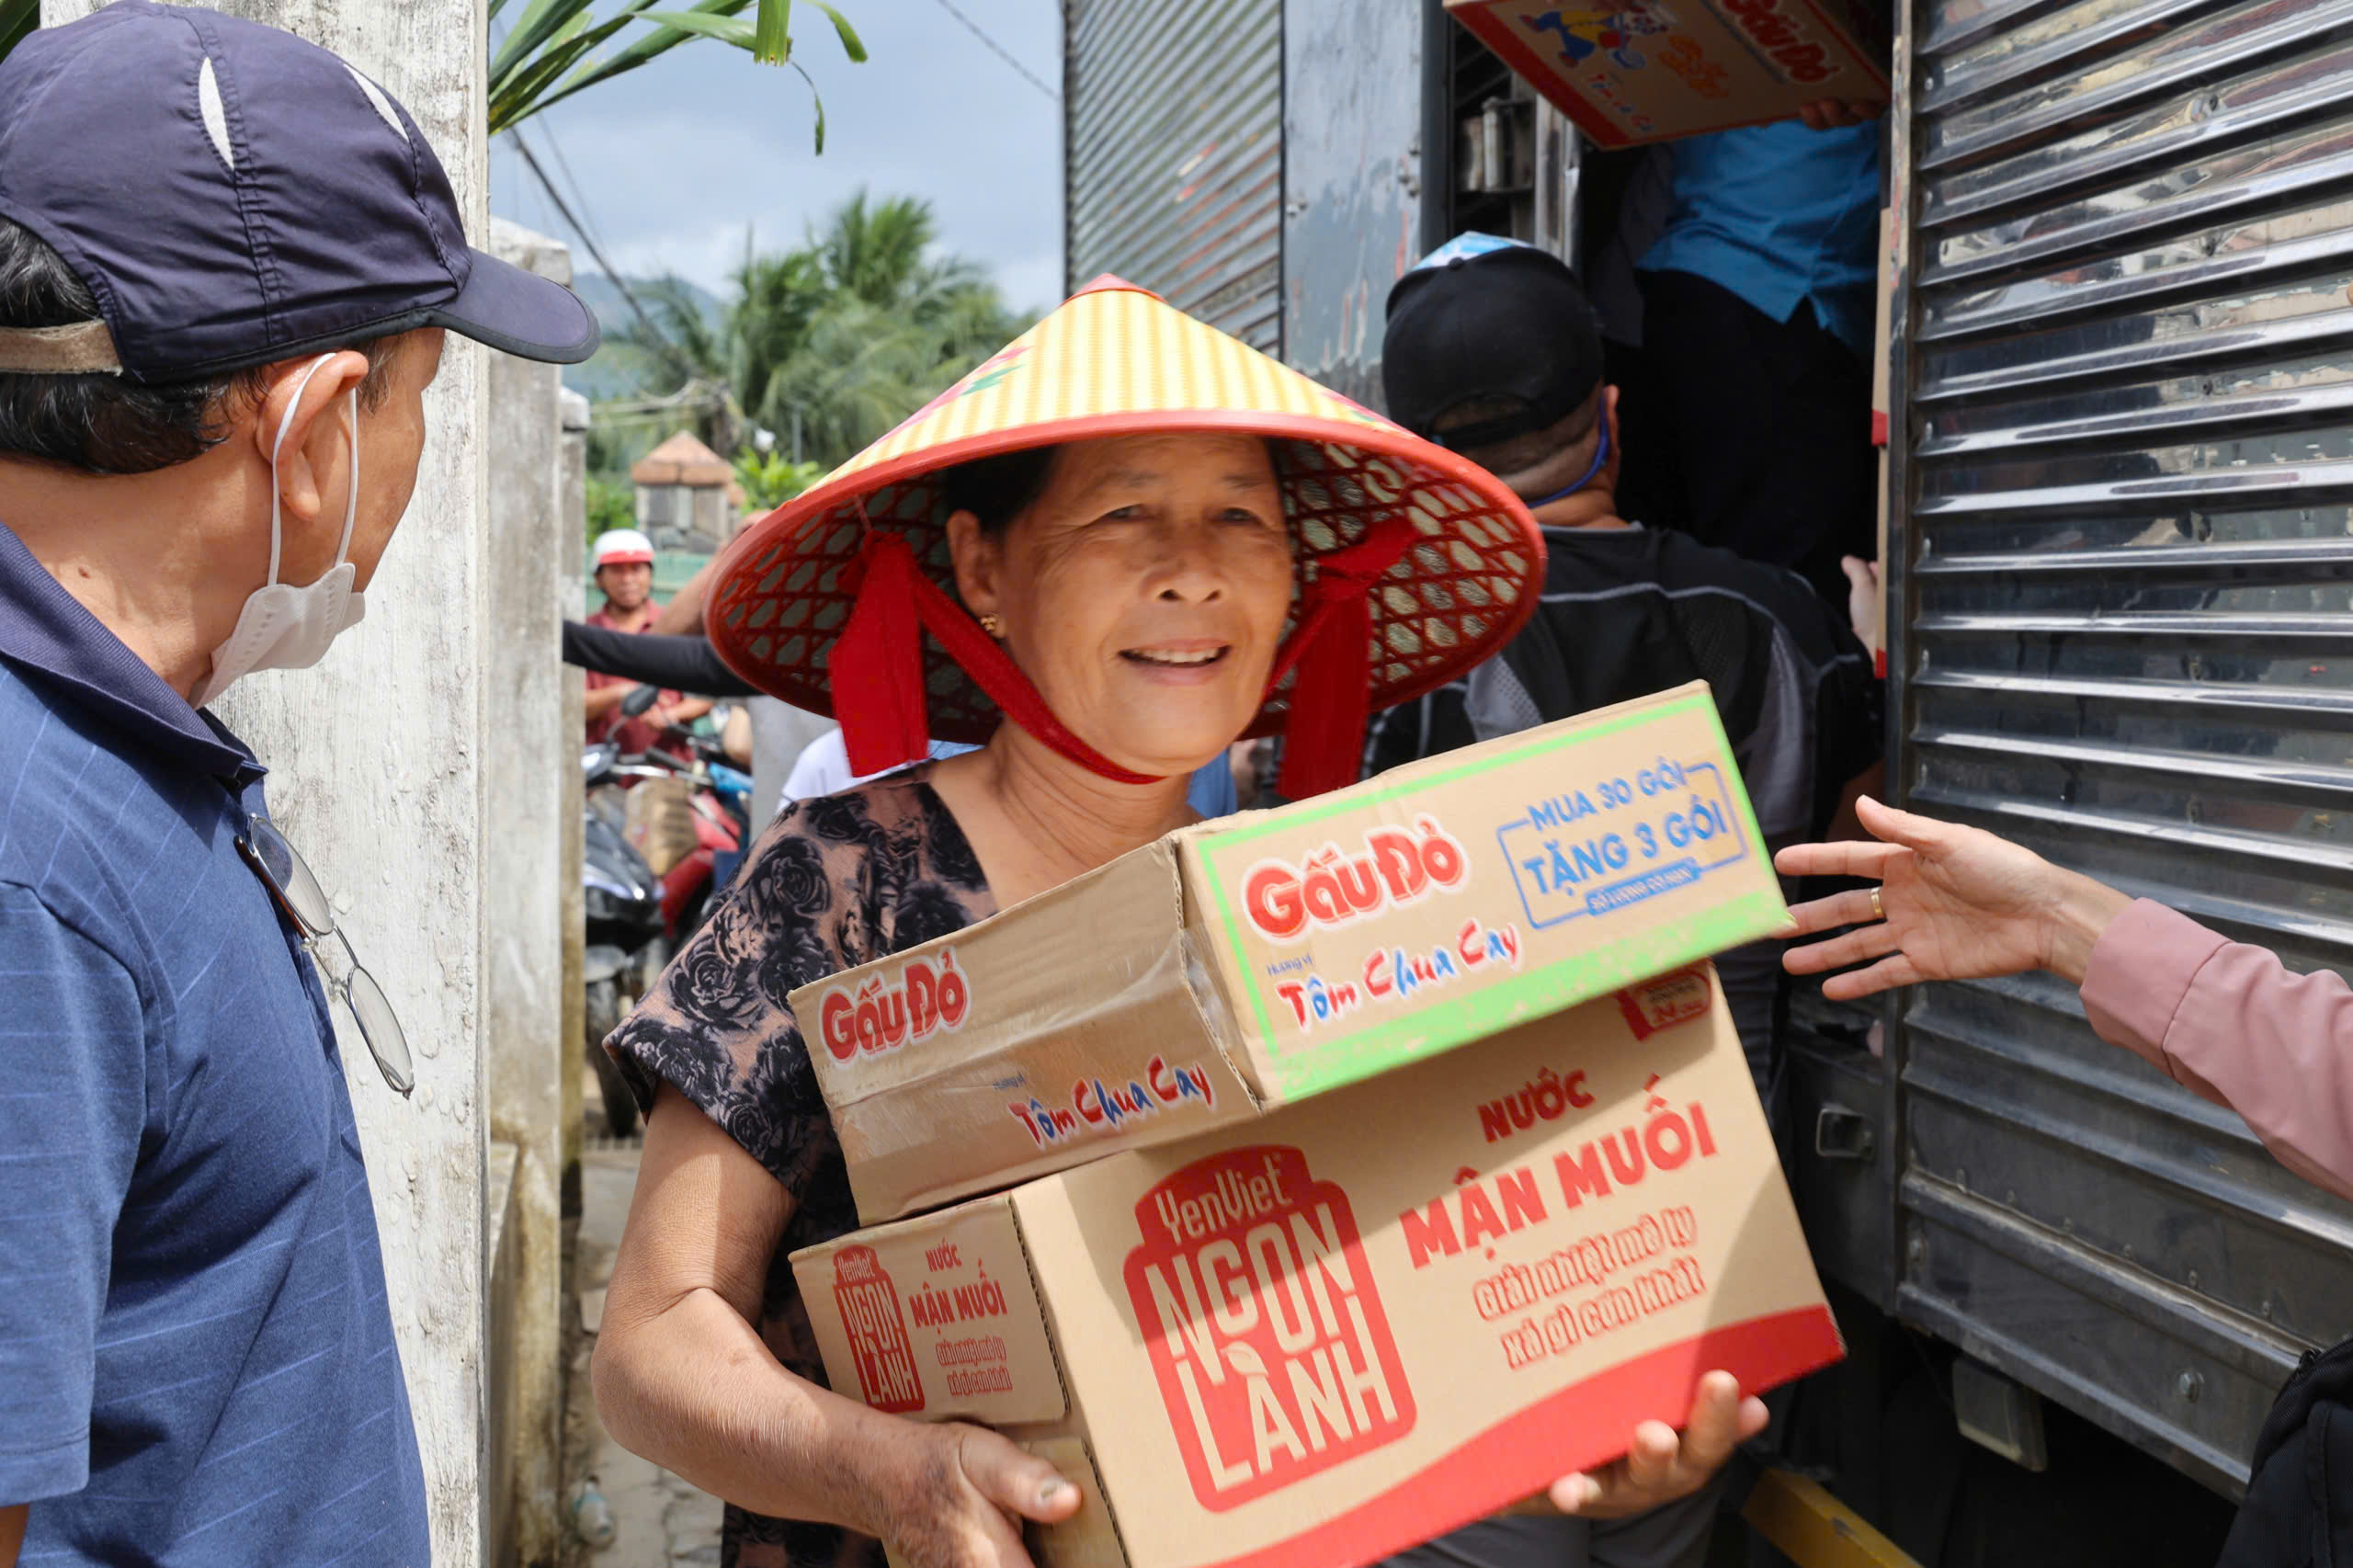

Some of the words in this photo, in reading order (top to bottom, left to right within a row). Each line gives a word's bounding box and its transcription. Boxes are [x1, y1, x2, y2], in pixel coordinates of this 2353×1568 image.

[1522, 830, 1629, 897] TẶNG
[1635, 823, 1658, 859] 3
[1665, 792, 1728, 849] GÓI
[1528, 790, 1596, 832] MUA
[1276, 975, 1358, 1028] Tôm
[1364, 947, 1457, 998] Chua
[1458, 919, 1518, 968] Cay
[1010, 1098, 1076, 1145] Tôm
[1074, 1080, 1153, 1124] Chua
[1147, 1055, 1212, 1107] Cay
[1477, 1066, 1597, 1143] NƯỚC
[1399, 1165, 1549, 1270] MẬN
[1553, 1072, 1718, 1211] MUỐI
[909, 1281, 956, 1335] MẬN
[953, 1258, 1007, 1322] MUỐI
[925, 1237, 962, 1273] NƯỚC
[837, 1280, 900, 1354] NGON
[1145, 1210, 1358, 1387] NGON
